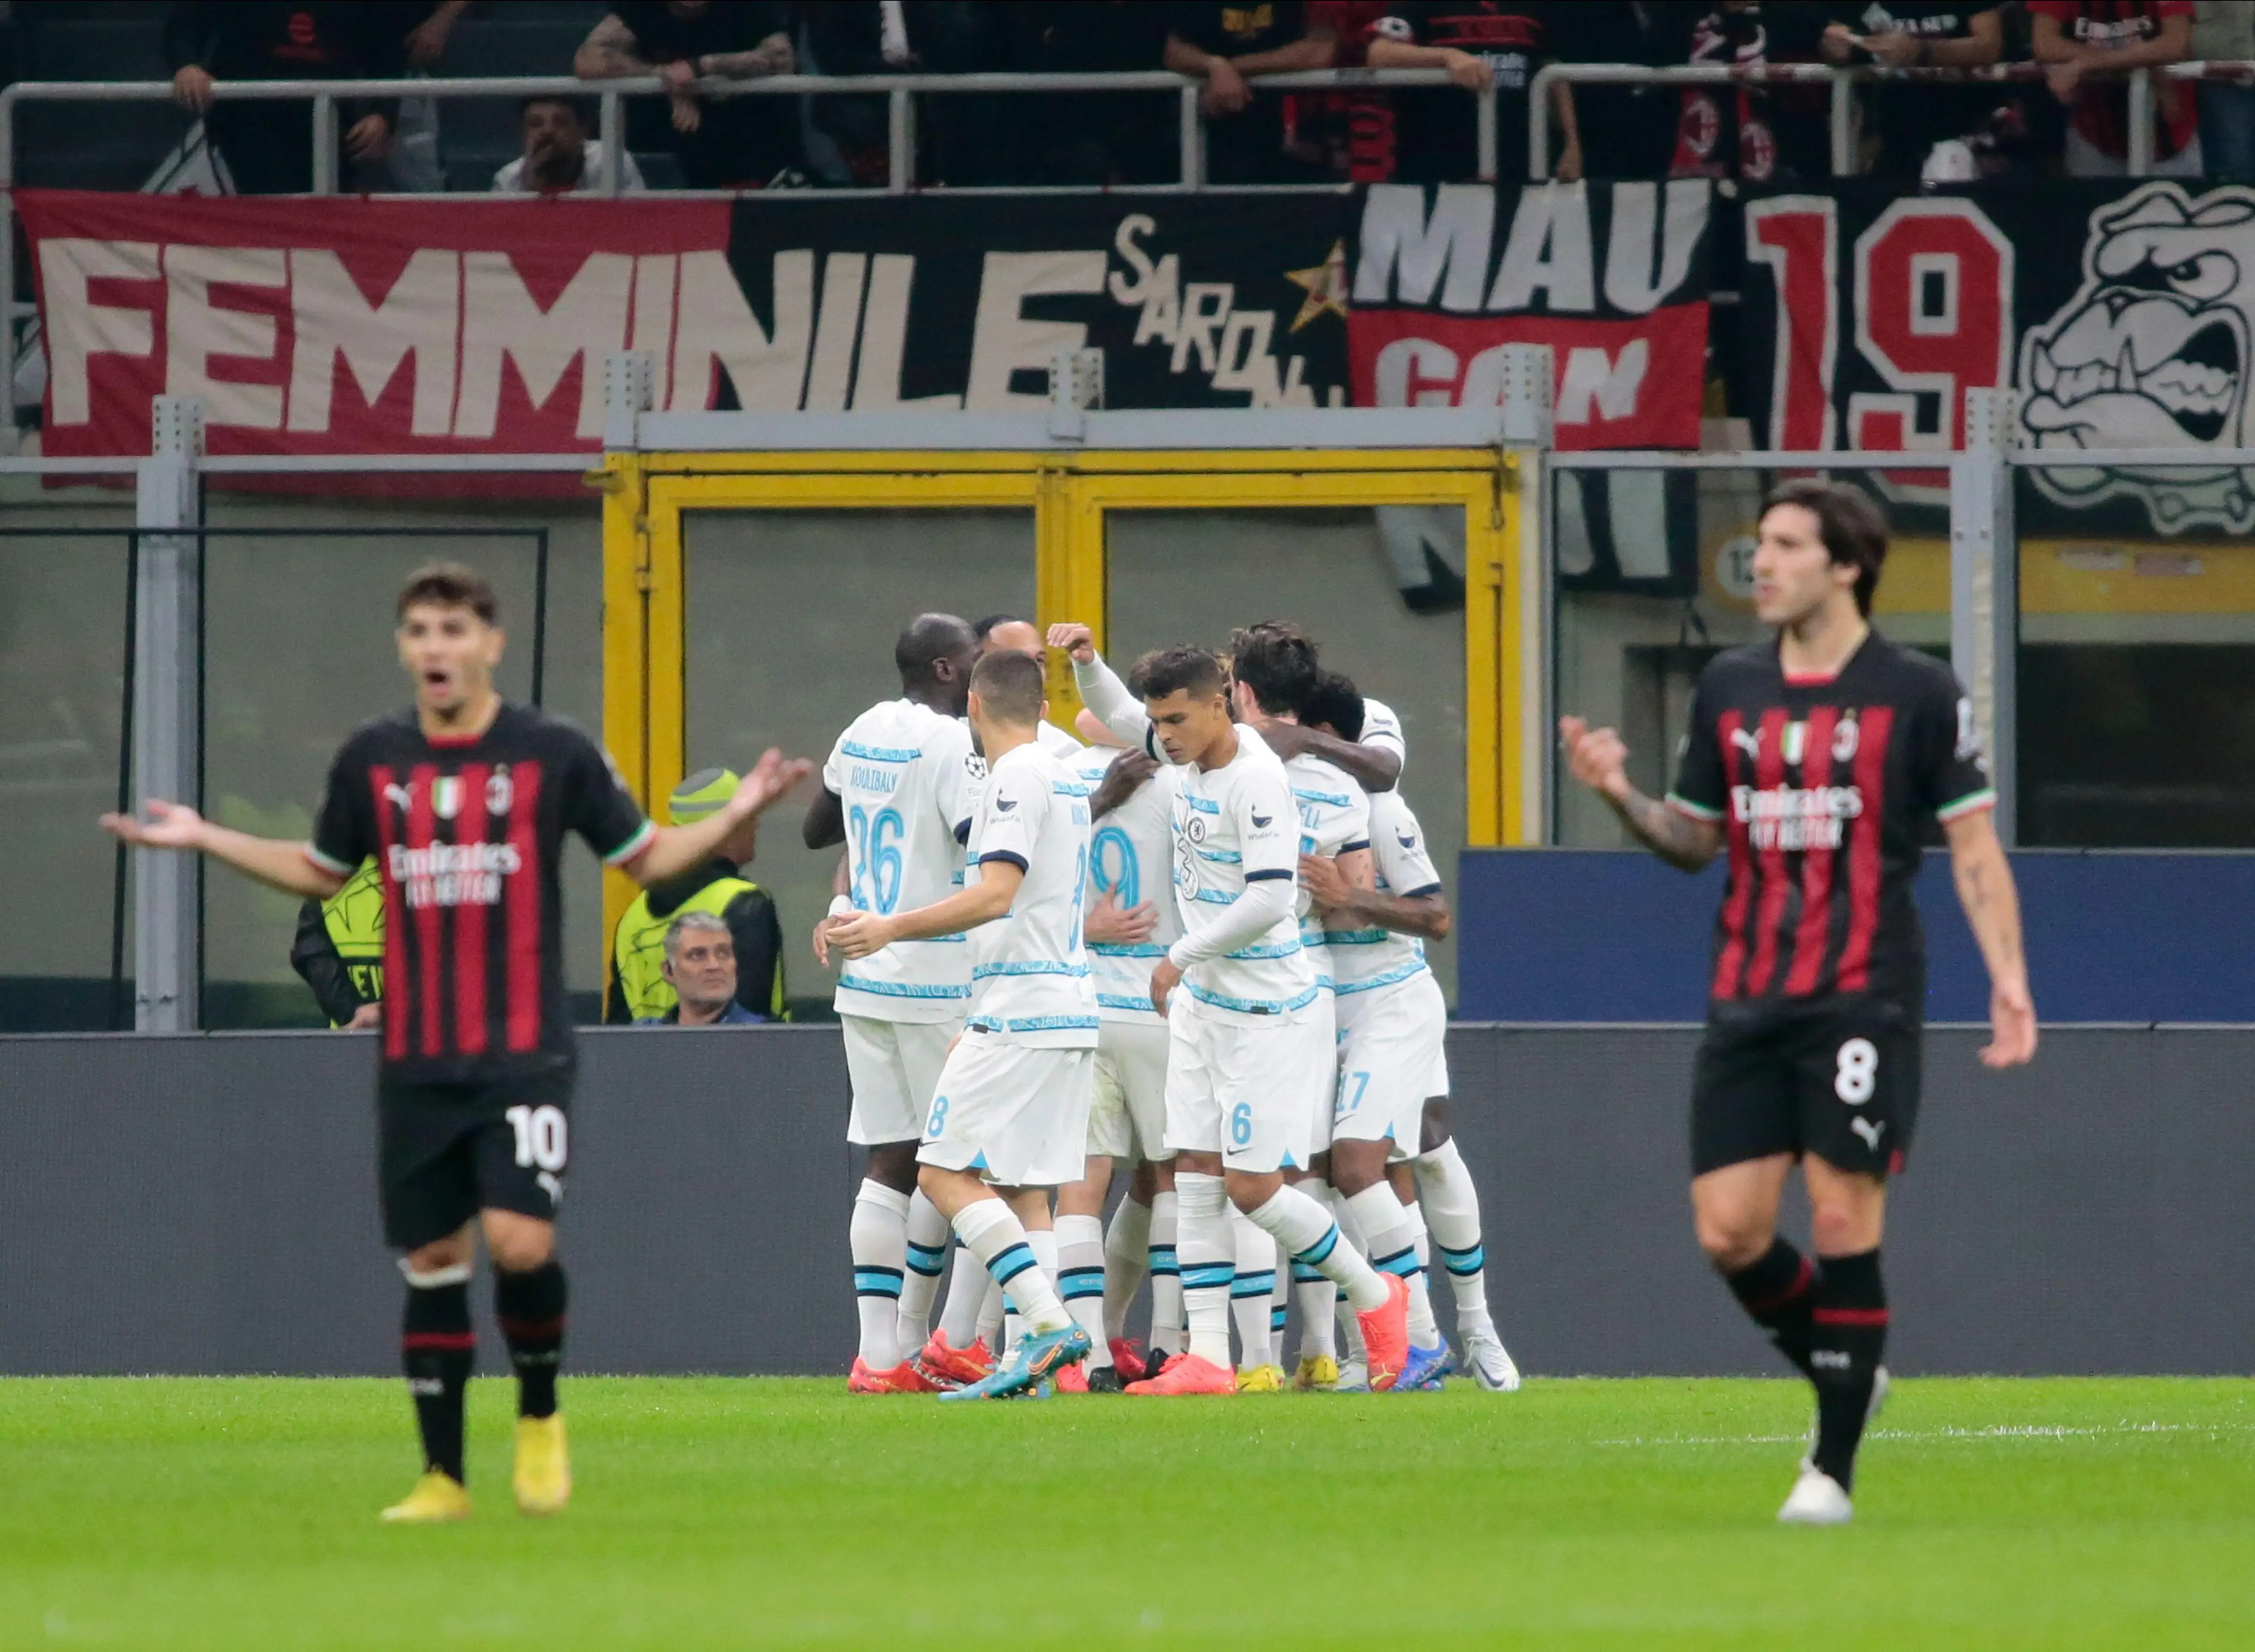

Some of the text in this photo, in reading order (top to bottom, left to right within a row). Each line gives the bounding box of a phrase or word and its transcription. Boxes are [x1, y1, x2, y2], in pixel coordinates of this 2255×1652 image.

[1353, 178, 1710, 313] MAU
[38, 237, 1108, 439] FEMMINILE
[1745, 194, 2014, 505] 19
[1835, 1037, 1879, 1105] 8
[506, 1104, 568, 1172] 10
[927, 1095, 949, 1138] 8
[1231, 1102, 1252, 1145] 6
